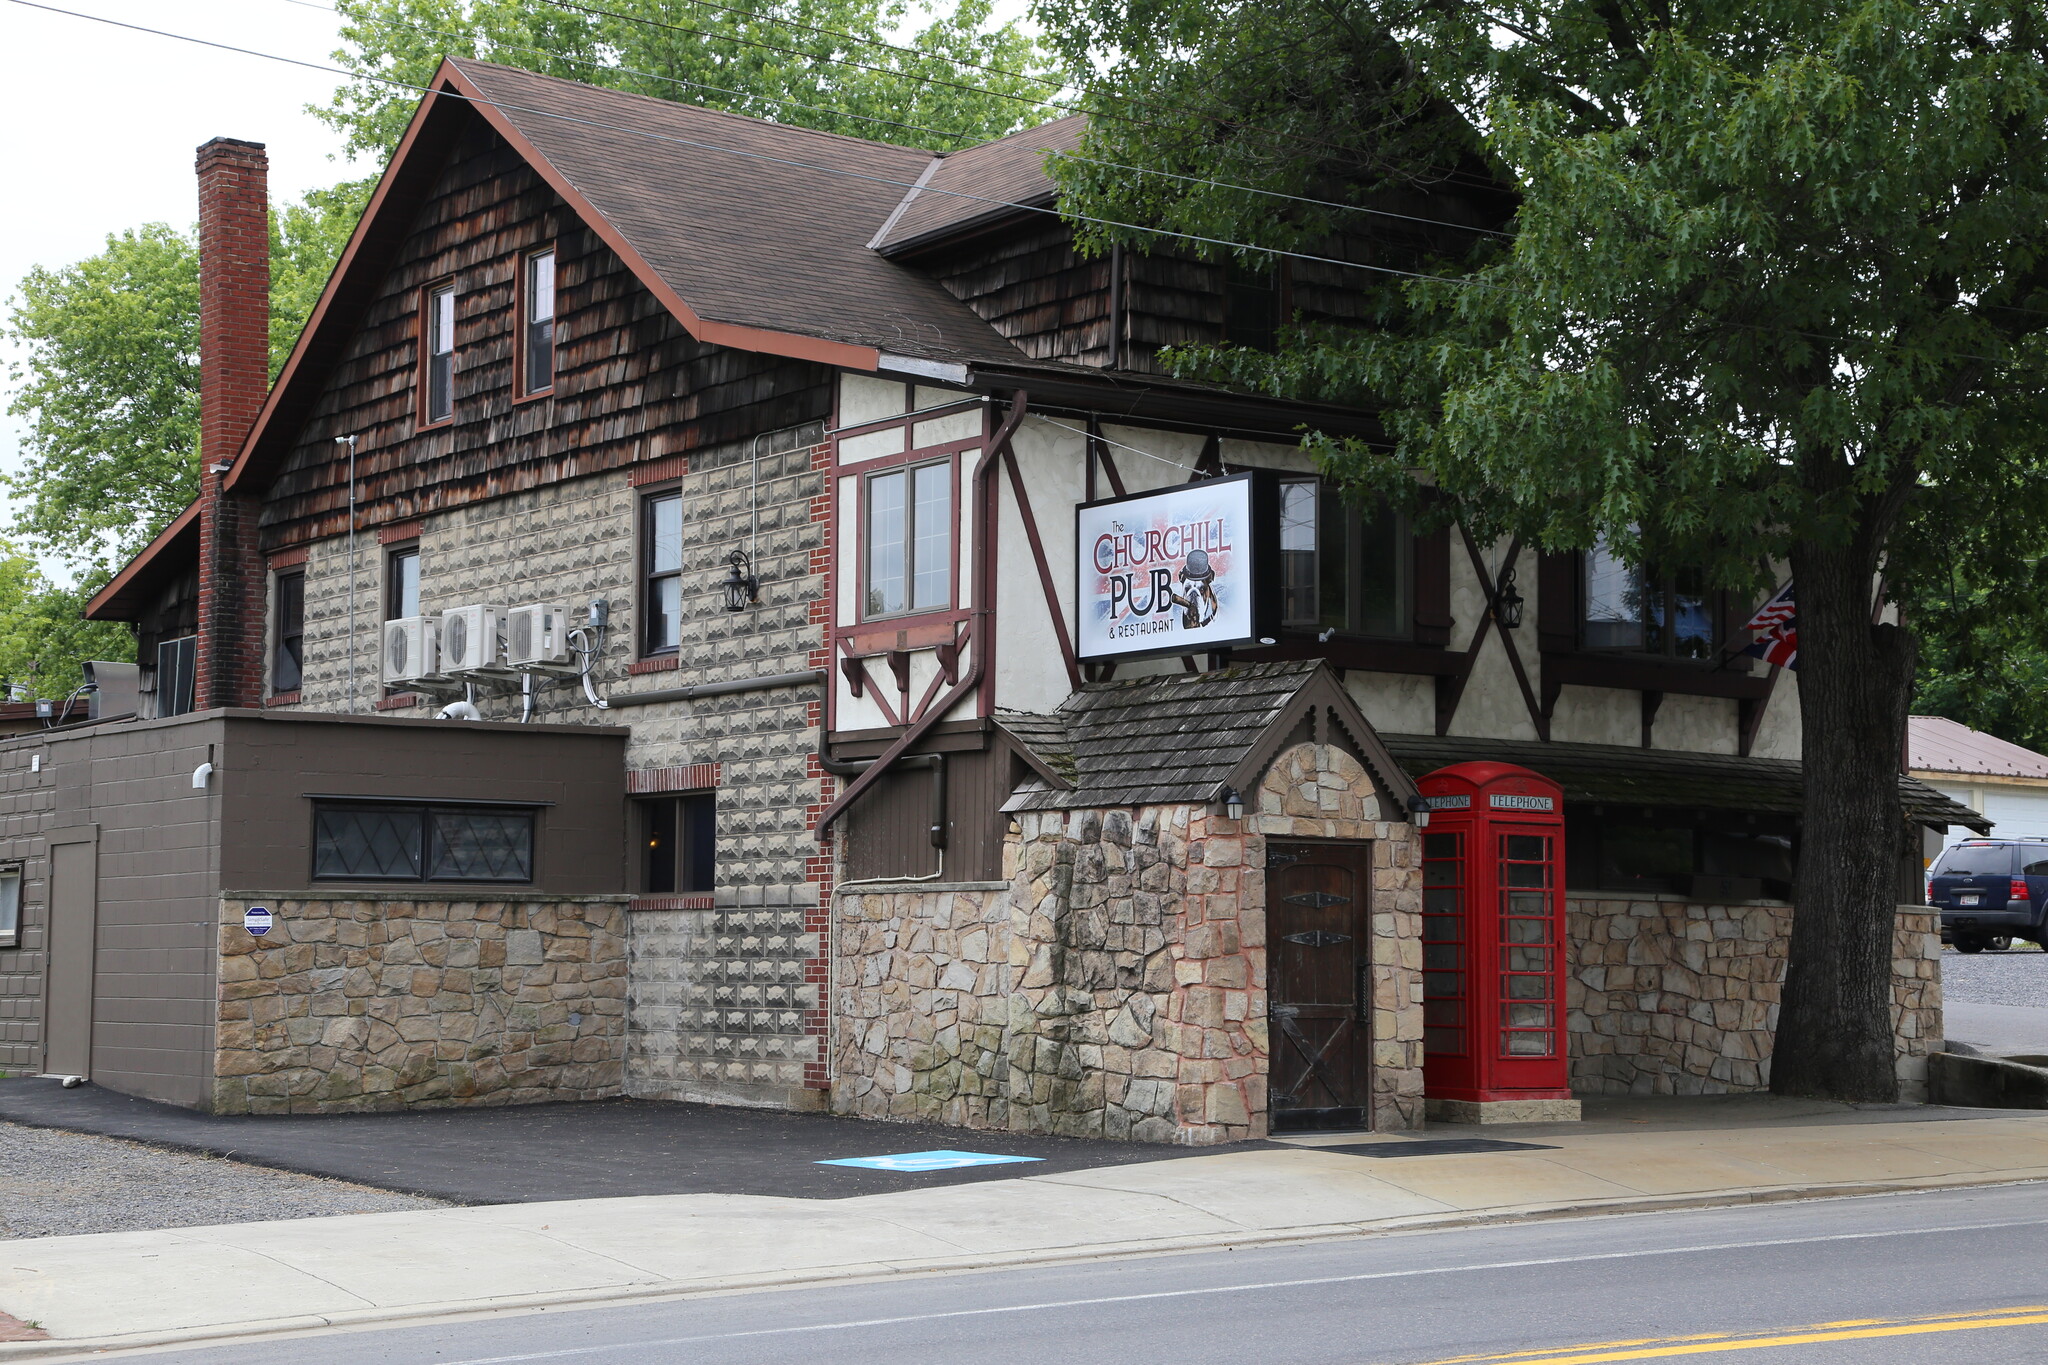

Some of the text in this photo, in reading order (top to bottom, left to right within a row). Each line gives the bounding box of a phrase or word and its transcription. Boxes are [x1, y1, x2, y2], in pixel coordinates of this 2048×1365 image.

[1112, 520, 1125, 533] The
[1093, 518, 1232, 575] CHURCHILL
[1109, 568, 1173, 620] PUB
[1108, 618, 1175, 640] & RESTAURANT
[1429, 795, 1470, 808] LEPHONE
[1491, 795, 1552, 809] TELEPHONE
